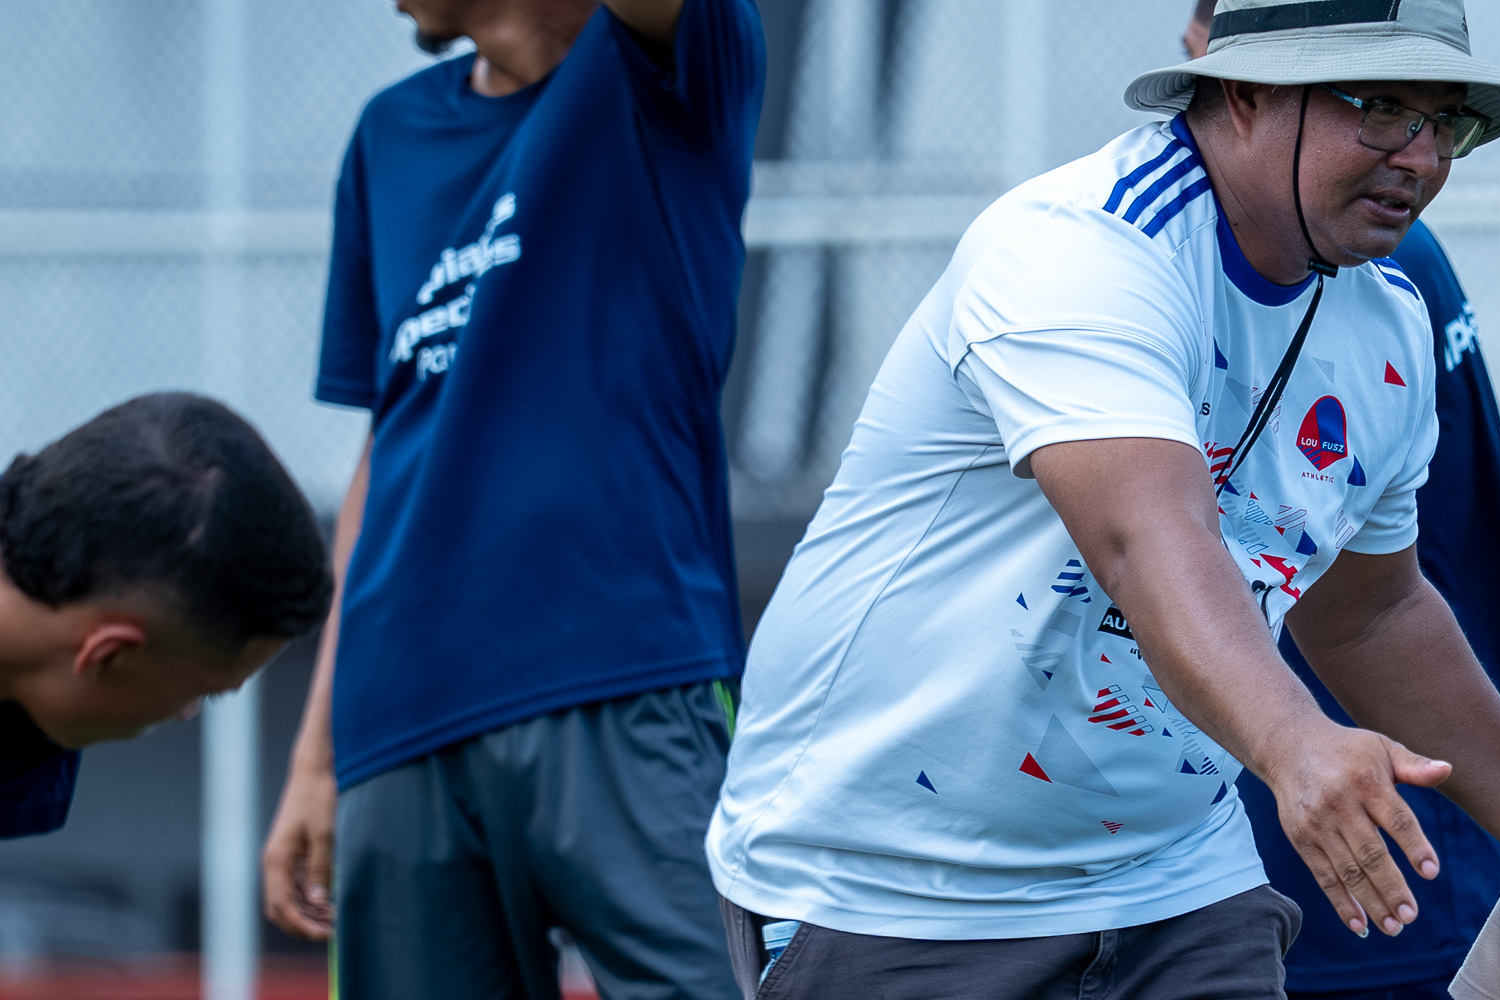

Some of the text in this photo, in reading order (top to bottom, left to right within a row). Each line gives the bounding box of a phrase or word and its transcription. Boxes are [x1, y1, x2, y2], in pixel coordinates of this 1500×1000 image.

[1300, 437, 1345, 453] LOU FUSZ
[1302, 472, 1334, 483] ATHLETIC
[1102, 614, 1132, 633] AU
